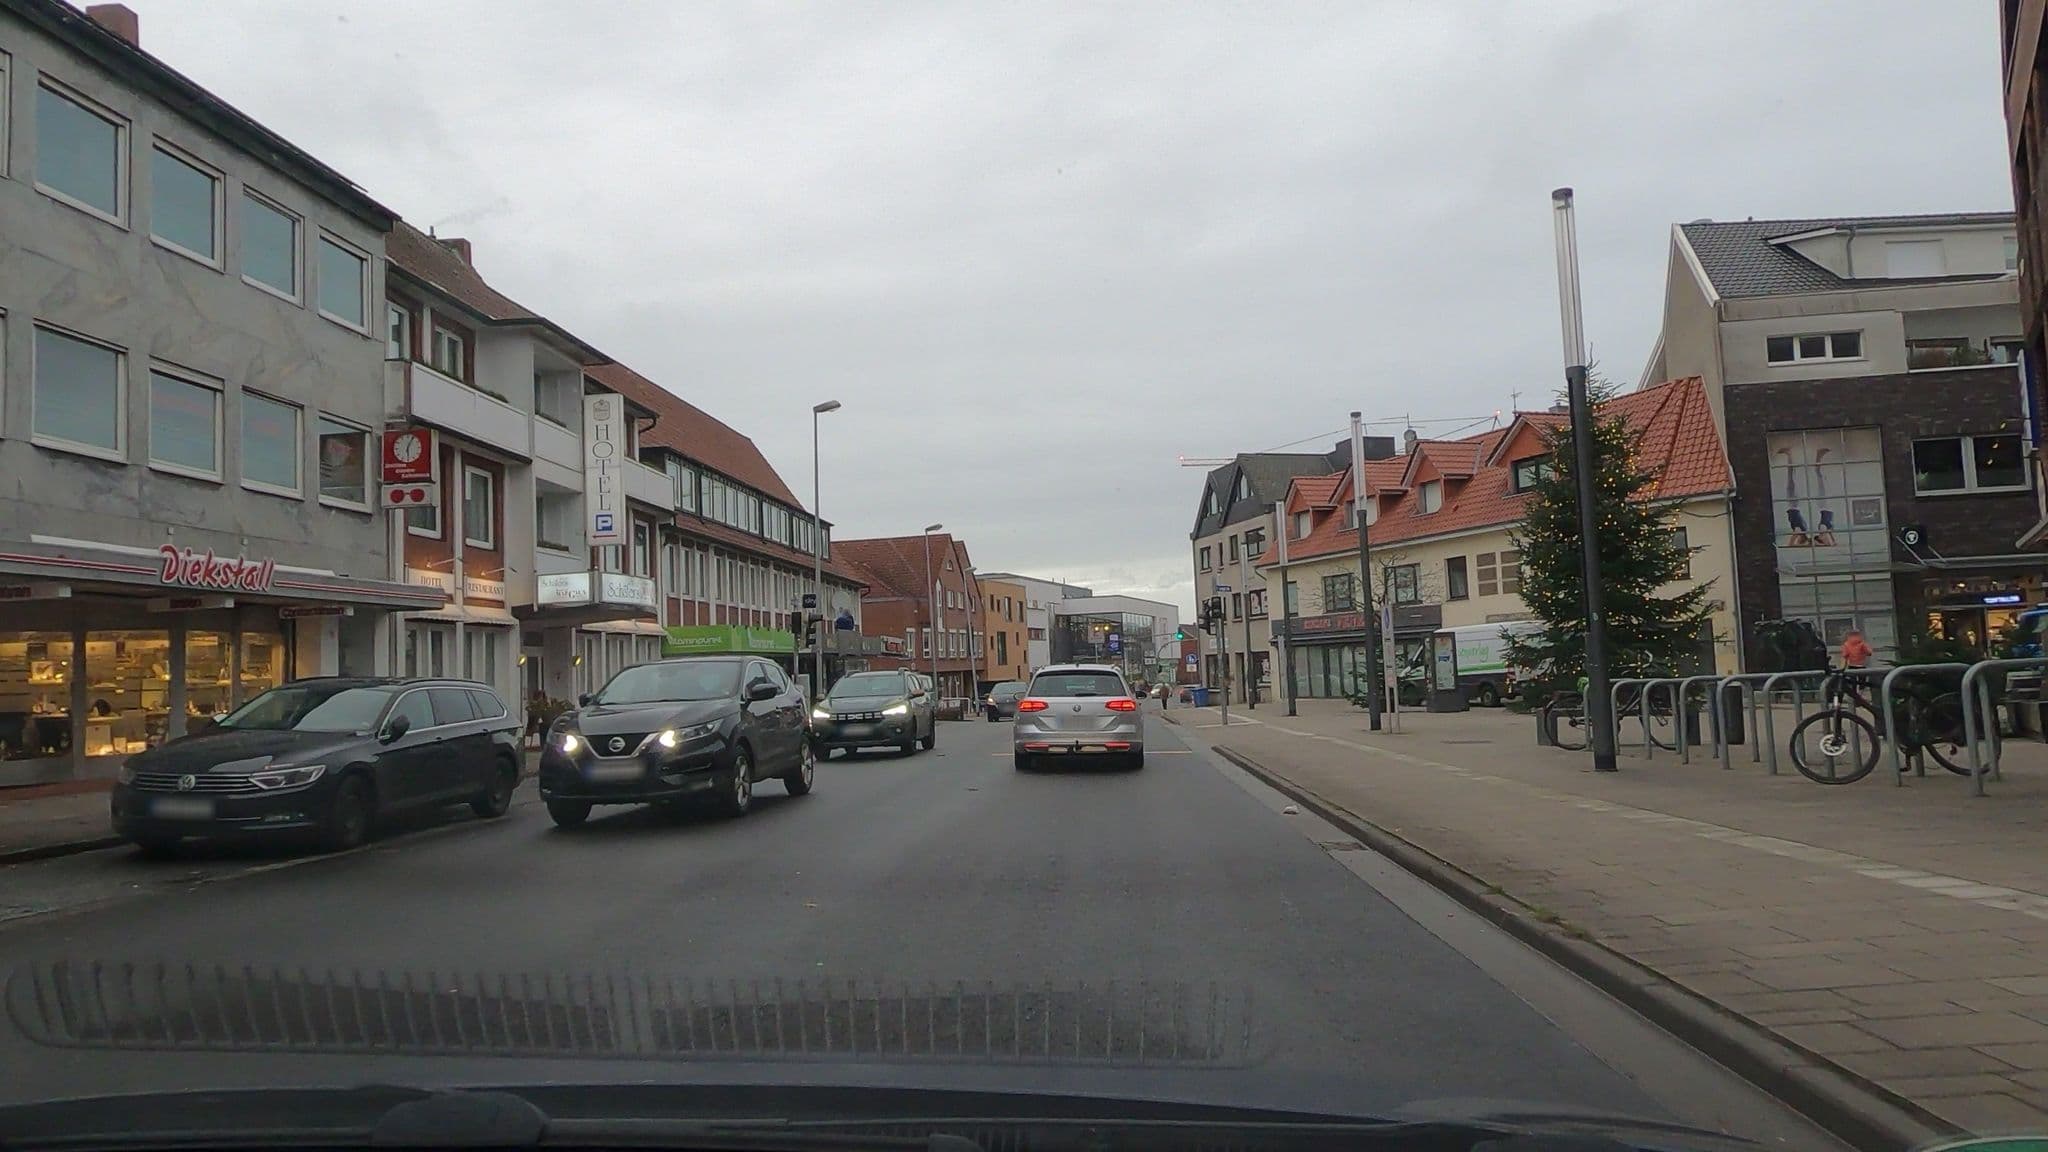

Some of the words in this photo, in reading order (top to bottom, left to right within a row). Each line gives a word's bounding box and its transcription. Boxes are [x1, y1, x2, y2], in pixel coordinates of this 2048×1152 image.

[592, 424, 614, 511] HOTEL
[160, 543, 275, 592] Diekstall
[420, 575, 442, 588] HOTEL
